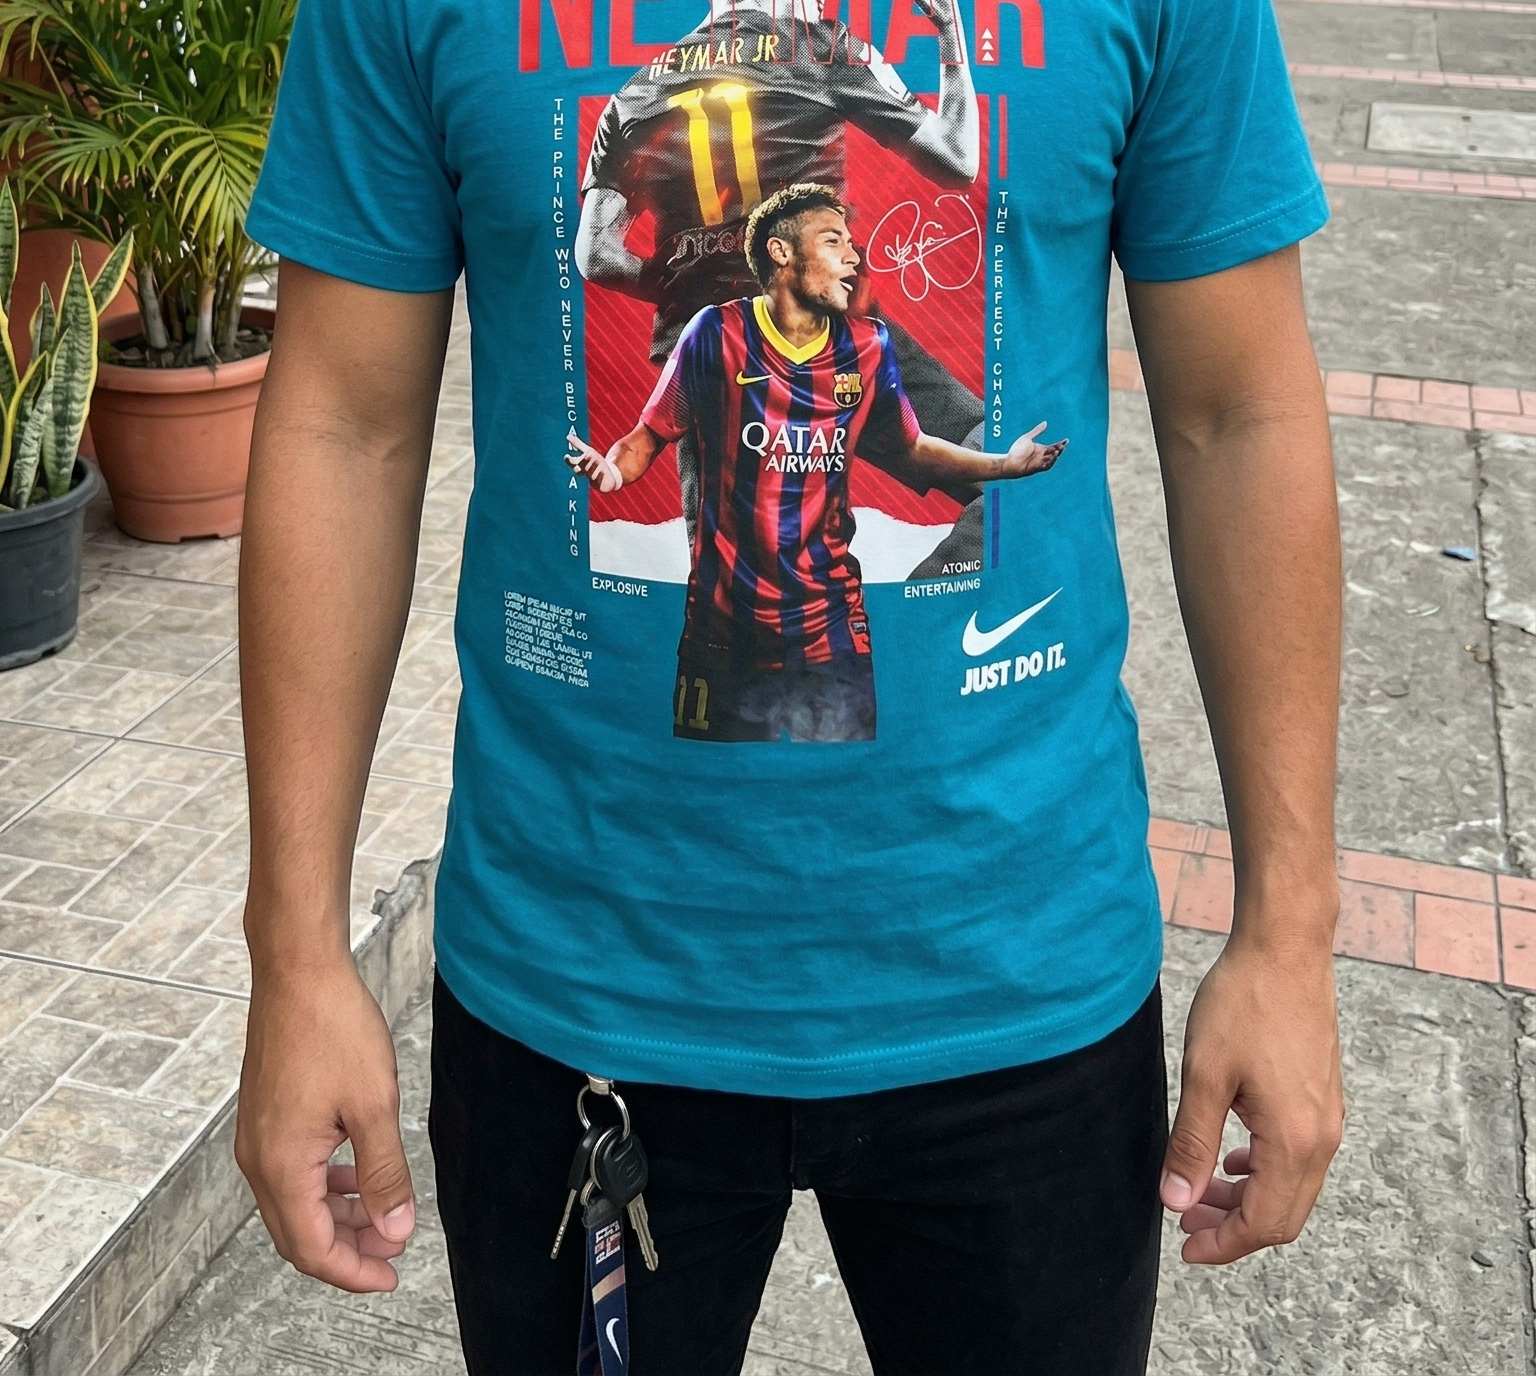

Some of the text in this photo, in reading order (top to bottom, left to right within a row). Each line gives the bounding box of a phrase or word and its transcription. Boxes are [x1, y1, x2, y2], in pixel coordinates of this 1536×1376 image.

[649, 34, 780, 80] NEYMAR JR
[553, 98, 564, 141] THE
[667, 82, 762, 227] 11
[553, 151, 565, 238] PRINCE
[555, 248, 571, 290] WHO
[561, 299, 573, 372] NEVER
[992, 191, 1009, 438] THE PERFECT CHAOS
[741, 421, 847, 458] QATAR
[568, 476, 579, 490] A
[765, 454, 846, 473] AIRWAYS
[568, 499, 579, 557] KING
[591, 576, 649, 598] EXPLOSIVE
[903, 577, 981, 599] ENTERTAINING
[960, 641, 1067, 696] JUST DO IT.
[675, 675, 710, 731] 11
